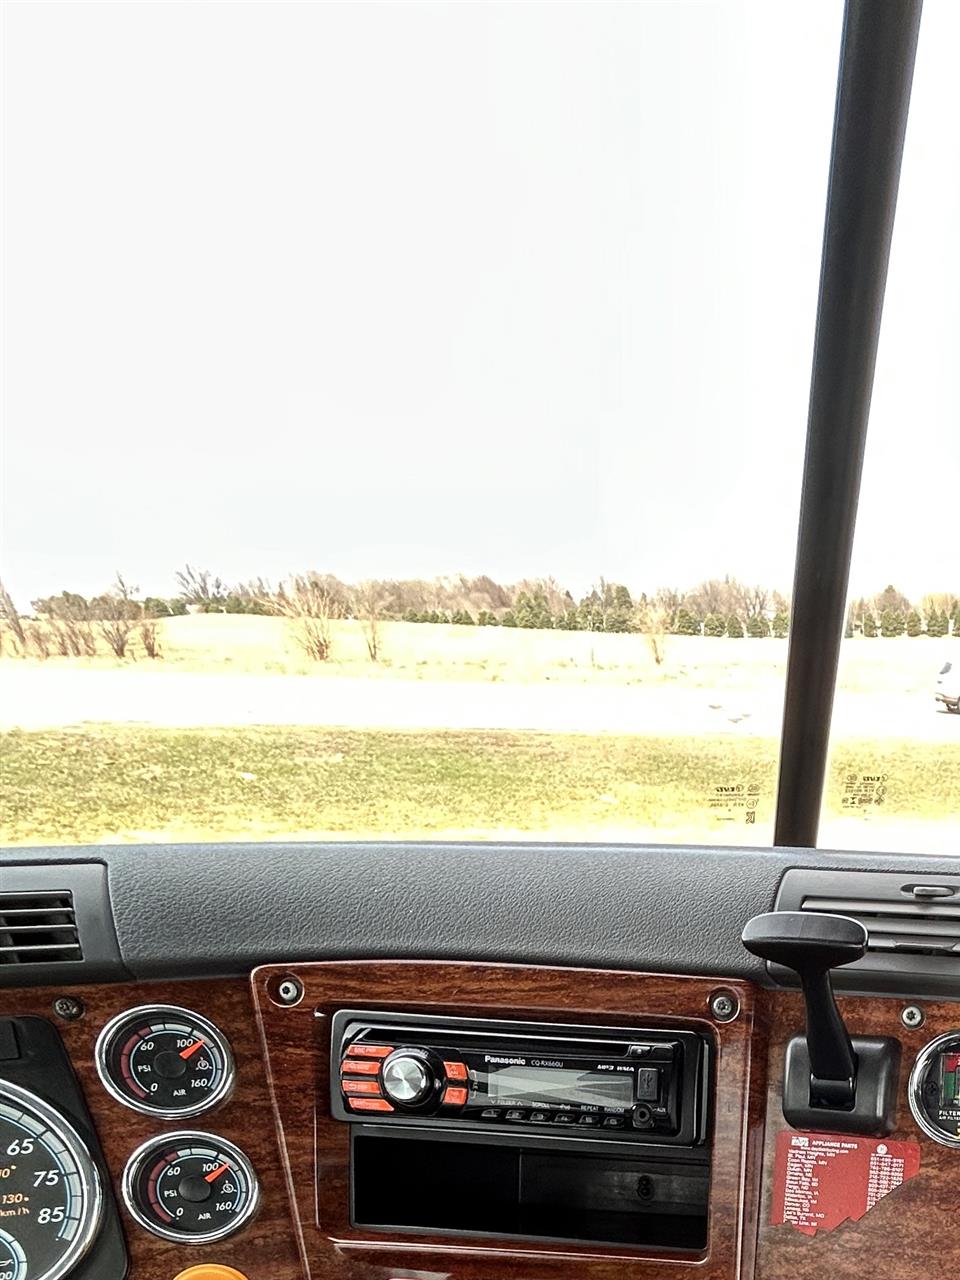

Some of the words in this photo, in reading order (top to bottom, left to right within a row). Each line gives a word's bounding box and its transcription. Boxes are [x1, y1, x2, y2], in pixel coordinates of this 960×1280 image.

[140, 1042, 154, 1051] 60
[176, 1039, 194, 1048] 100
[485, 1055, 526, 1066] Panasonic
[150, 1083, 158, 1091] 0
[191, 1079, 208, 1087] 160
[7, 1138, 34, 1156] 65
[167, 1167, 180, 1176] 60
[202, 1163, 219, 1172] 100
[33, 1169, 60, 1187] 75
[216, 1202, 232, 1211] 160
[37, 1206, 65, 1224] 85
[176, 1208, 184, 1216] 0
